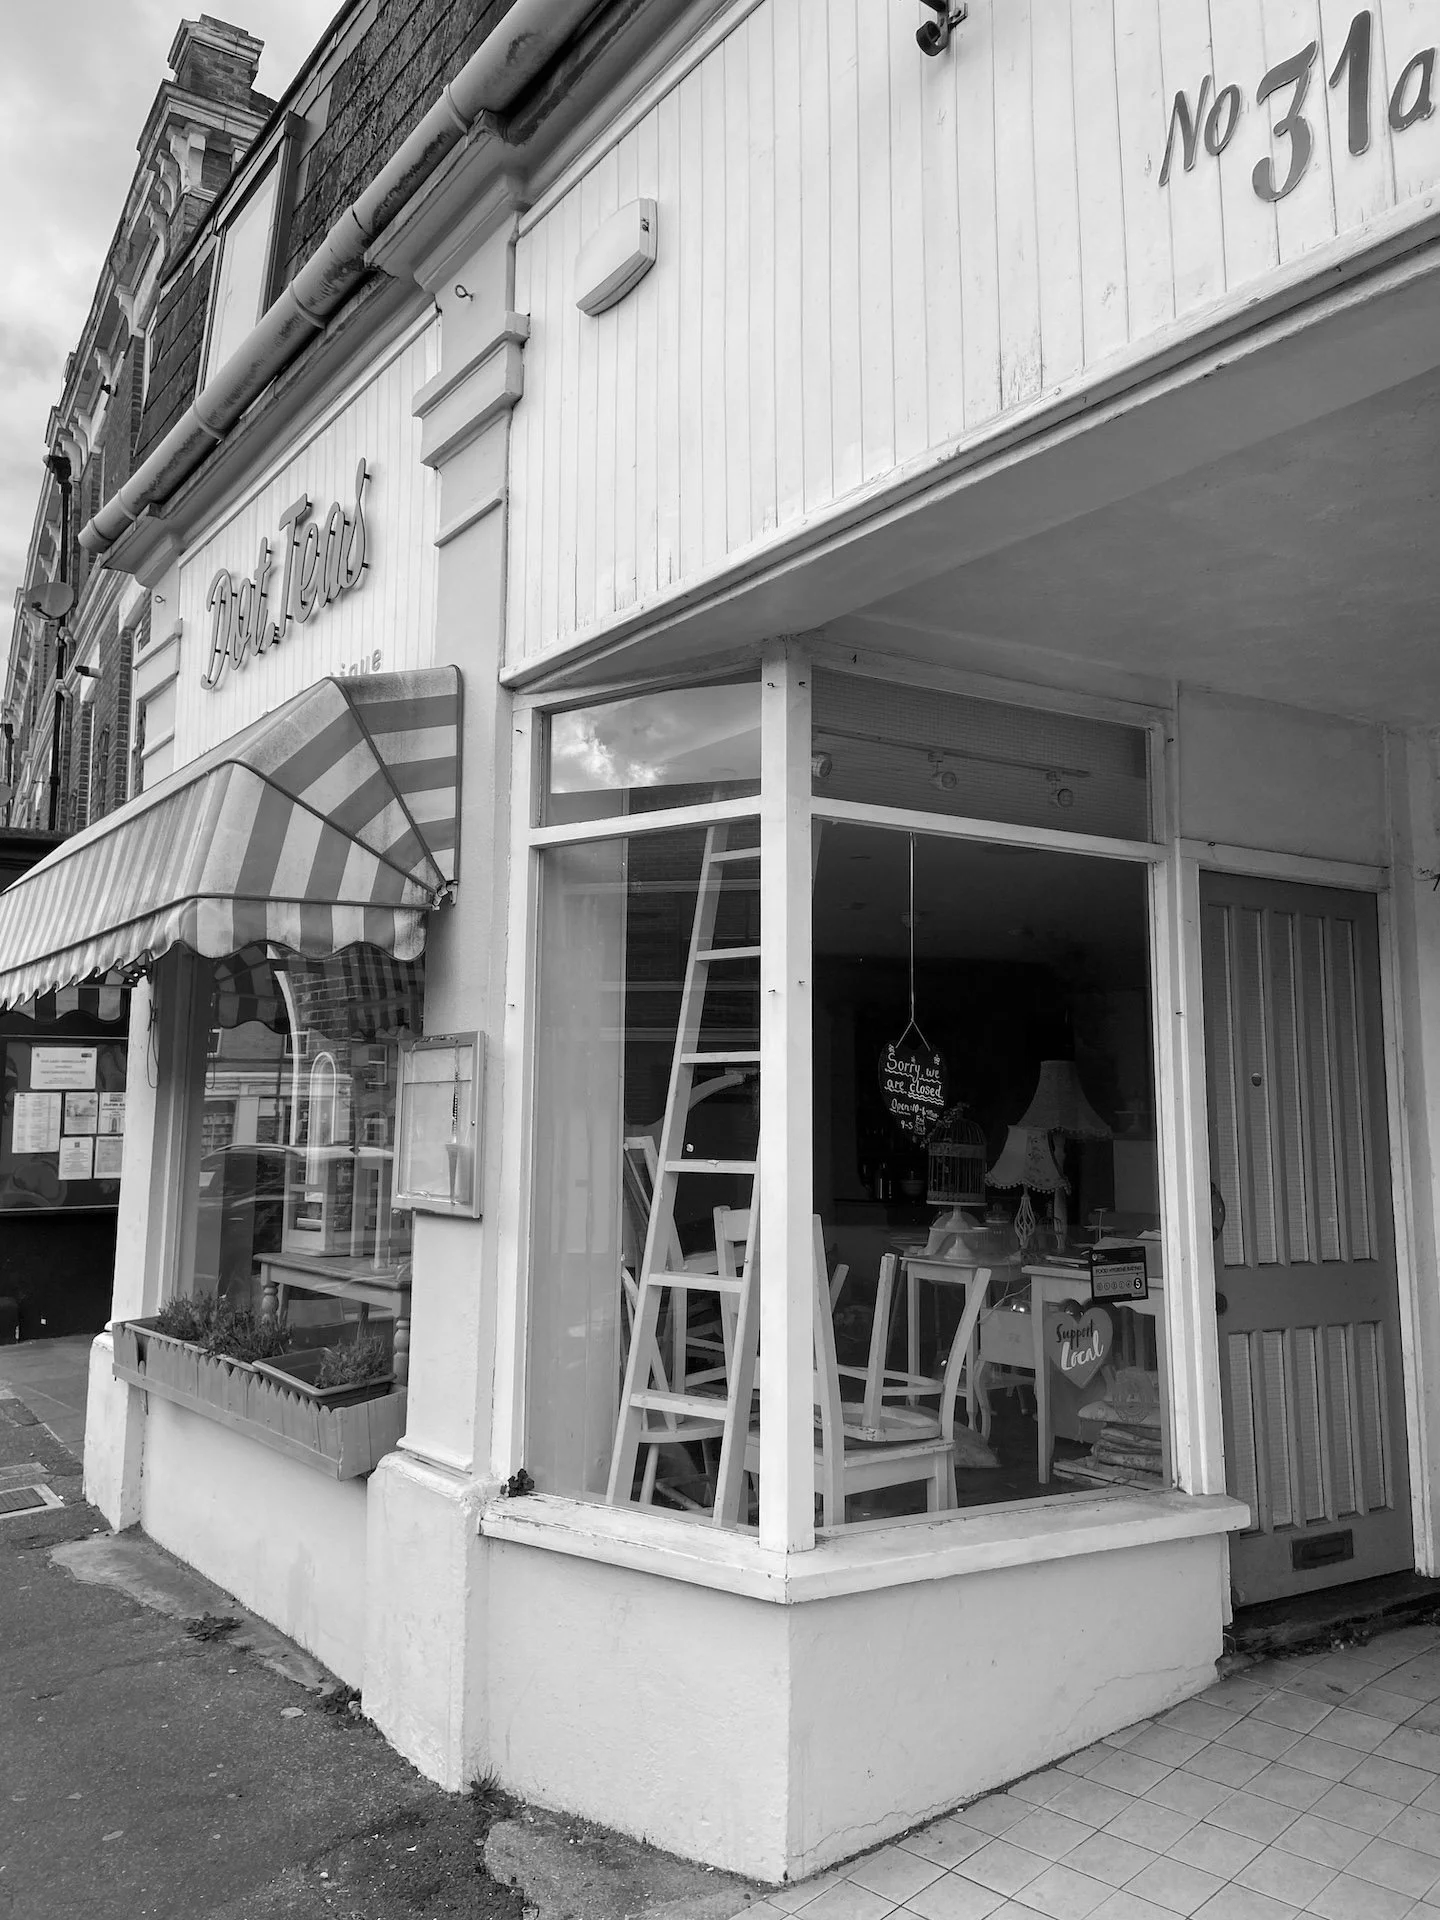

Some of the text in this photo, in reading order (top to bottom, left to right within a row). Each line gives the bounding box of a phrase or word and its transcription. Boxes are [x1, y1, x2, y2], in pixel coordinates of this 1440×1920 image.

[1158, 9, 1439, 203] No 31a
[925, 1068, 941, 1079] we
[886, 1079, 905, 1091] are
[1135, 1278, 1141, 1289] 5
[1056, 1319, 1104, 1371] Support Local
